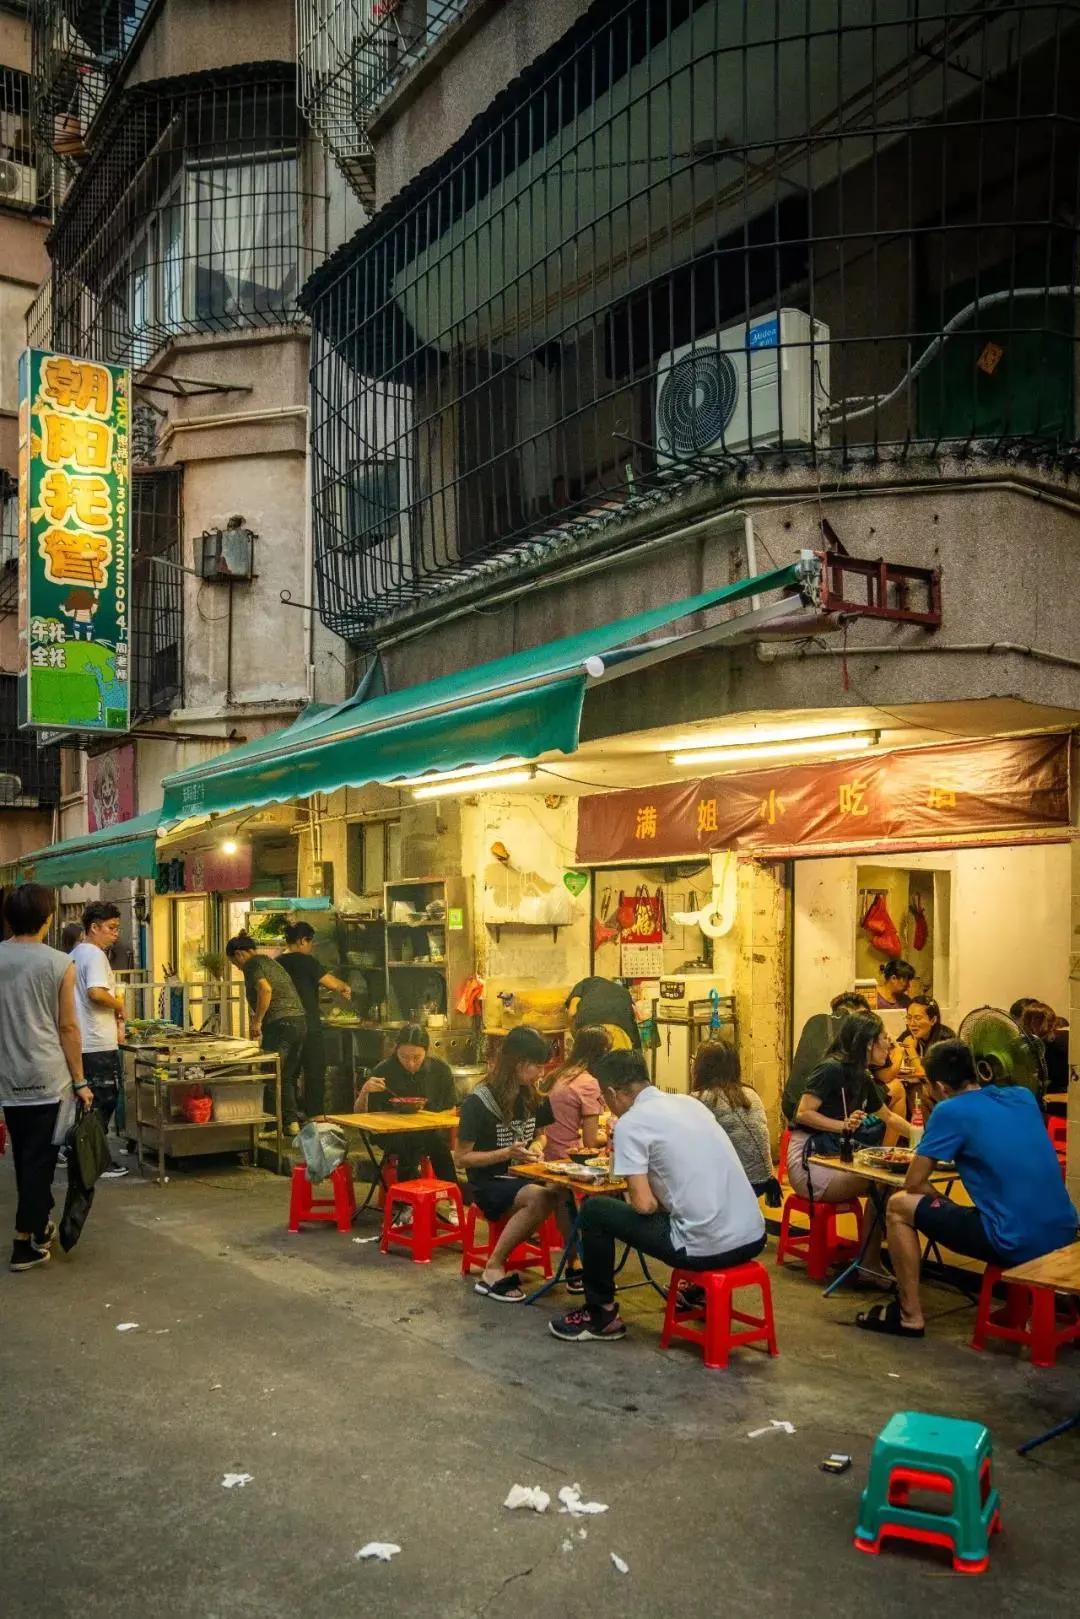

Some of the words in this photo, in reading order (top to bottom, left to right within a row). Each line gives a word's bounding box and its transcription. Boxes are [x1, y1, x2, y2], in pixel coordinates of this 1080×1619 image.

[750, 329, 777, 345] Midea
[41, 356, 112, 587] 朝阳托管
[115, 474, 127, 628] 13612225004
[32, 620, 66, 643] 午托
[32, 645, 66, 668] 全托
